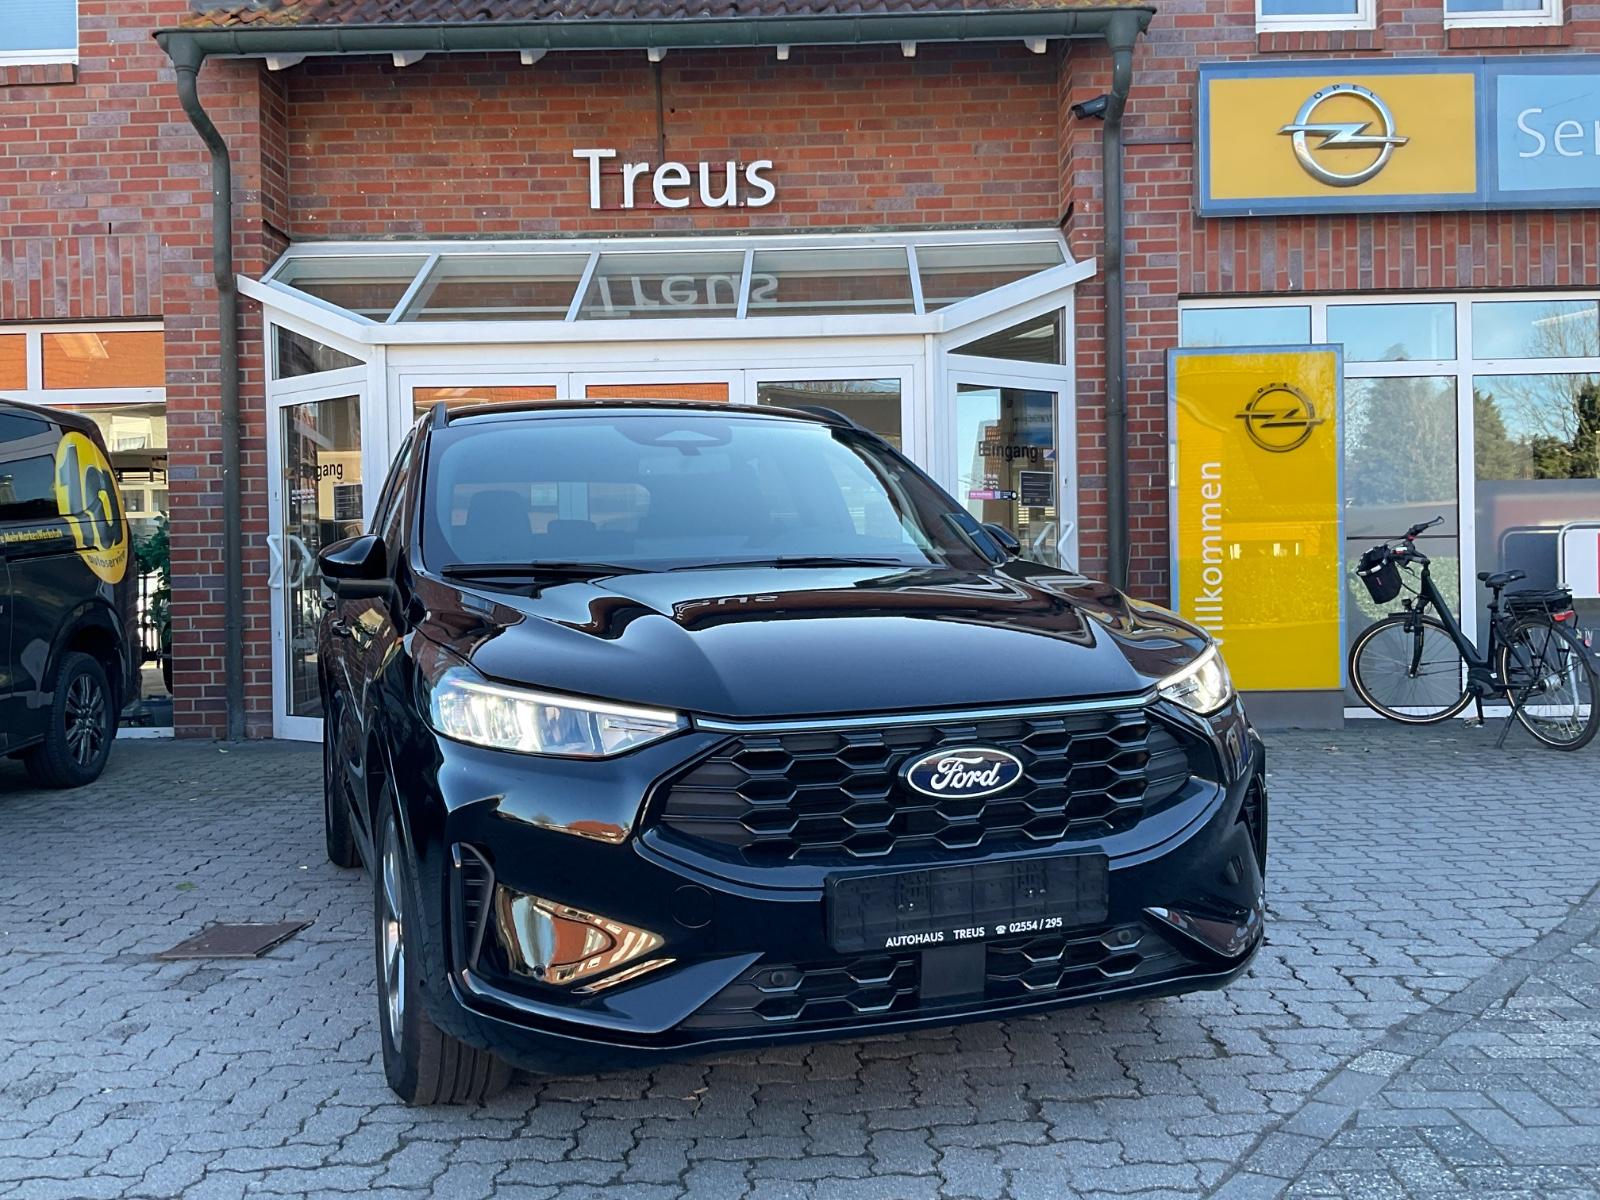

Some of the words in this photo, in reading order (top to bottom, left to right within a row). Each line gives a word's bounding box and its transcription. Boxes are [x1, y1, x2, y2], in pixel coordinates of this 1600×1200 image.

[1313, 84, 1376, 99] OPEL
[573, 149, 776, 209] Treus
[978, 441, 1040, 463] Eingang
[297, 463, 344, 481] gang
[1194, 461, 1224, 646] illkommen
[931, 756, 1001, 790] Ford
[885, 931, 944, 948] AUTOHAUS
[952, 926, 986, 940] TREUS
